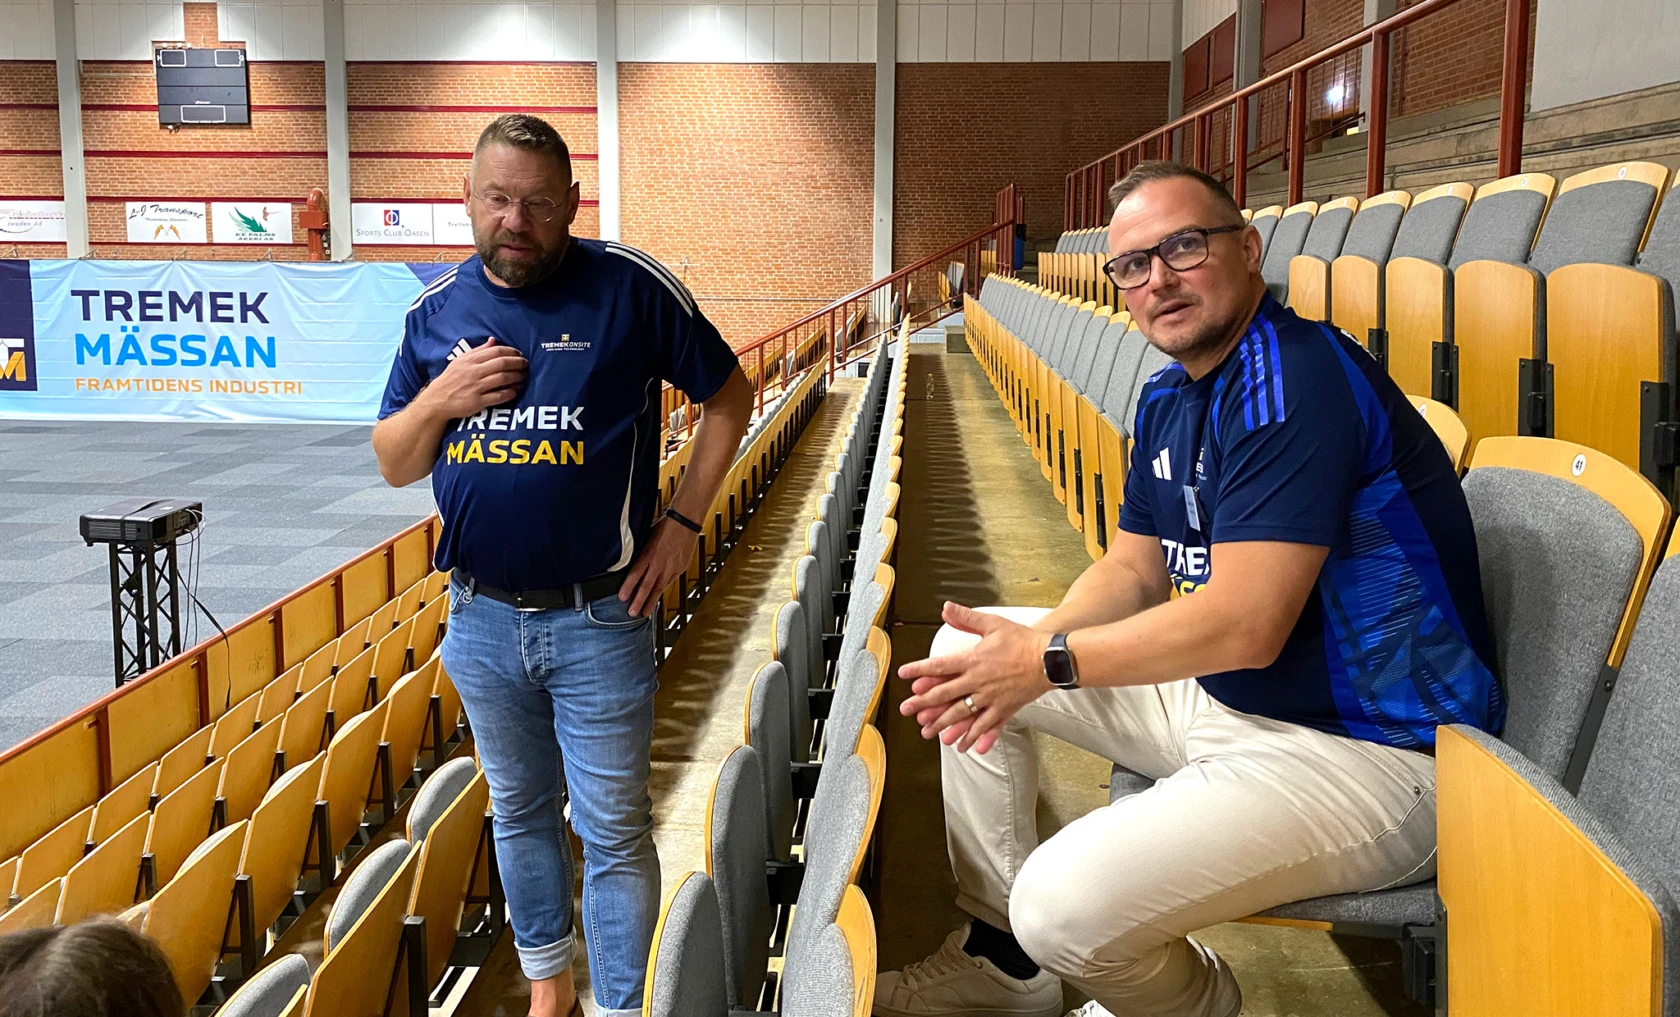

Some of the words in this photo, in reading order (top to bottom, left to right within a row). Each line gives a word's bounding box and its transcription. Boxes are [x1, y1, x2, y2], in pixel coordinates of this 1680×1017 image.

[150, 204, 204, 219] Transport
[71, 289, 270, 324] TREMEK
[75, 325, 276, 368] MÄSSAN
[75, 377, 203, 393] FRAMTIDENS
[209, 380, 302, 395] INDUSTRI
[446, 433, 585, 466] MÄSSAN
[1575, 459, 1584, 471] 41
